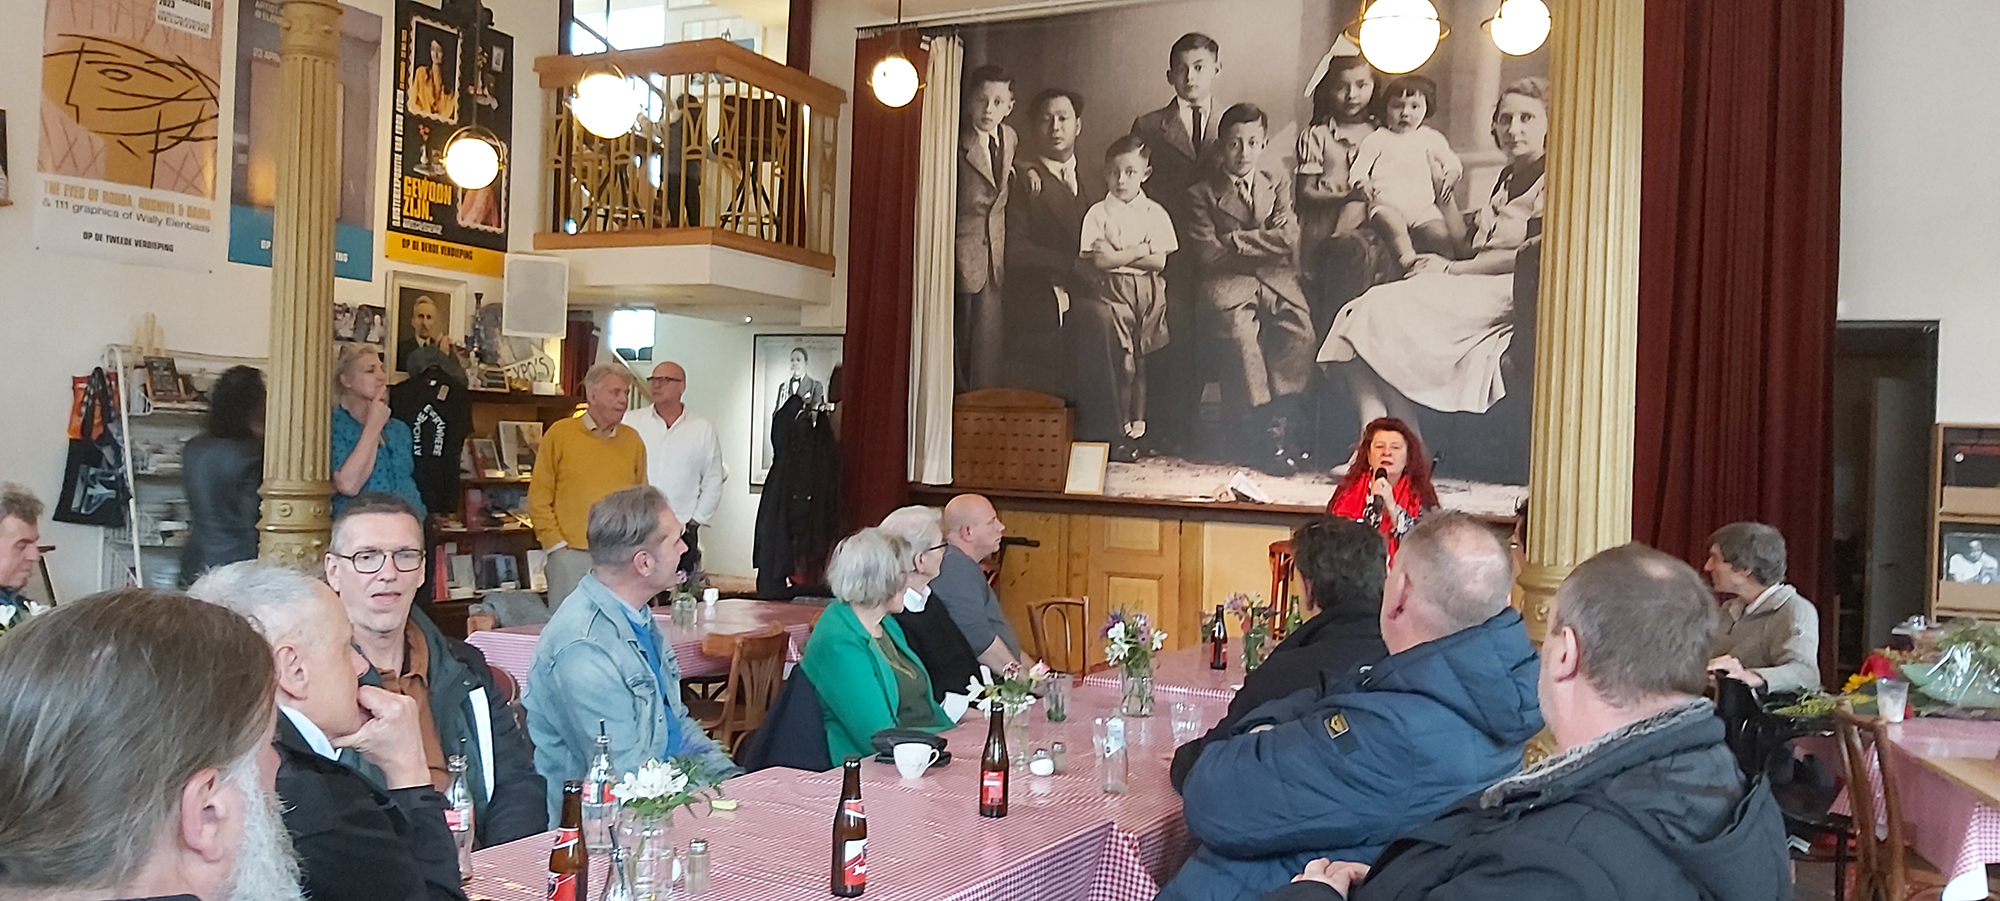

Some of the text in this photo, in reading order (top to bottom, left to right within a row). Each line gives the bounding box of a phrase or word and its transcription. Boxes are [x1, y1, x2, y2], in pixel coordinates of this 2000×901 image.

[403, 175, 453, 206] GEWOON
[72, 202, 120, 219] graphics
[122, 210, 133, 221] of
[135, 212, 164, 228] Wally
[82, 231, 175, 253] OP DE TWEEDE VERDIEPING
[260, 239, 272, 250] OP
[402, 238, 411, 249] OP
[412, 240, 420, 251] DE
[440, 245, 473, 260] VERDIEPING
[412, 411, 429, 456] AT HOME
[423, 404, 446, 457] EERYWHERE
